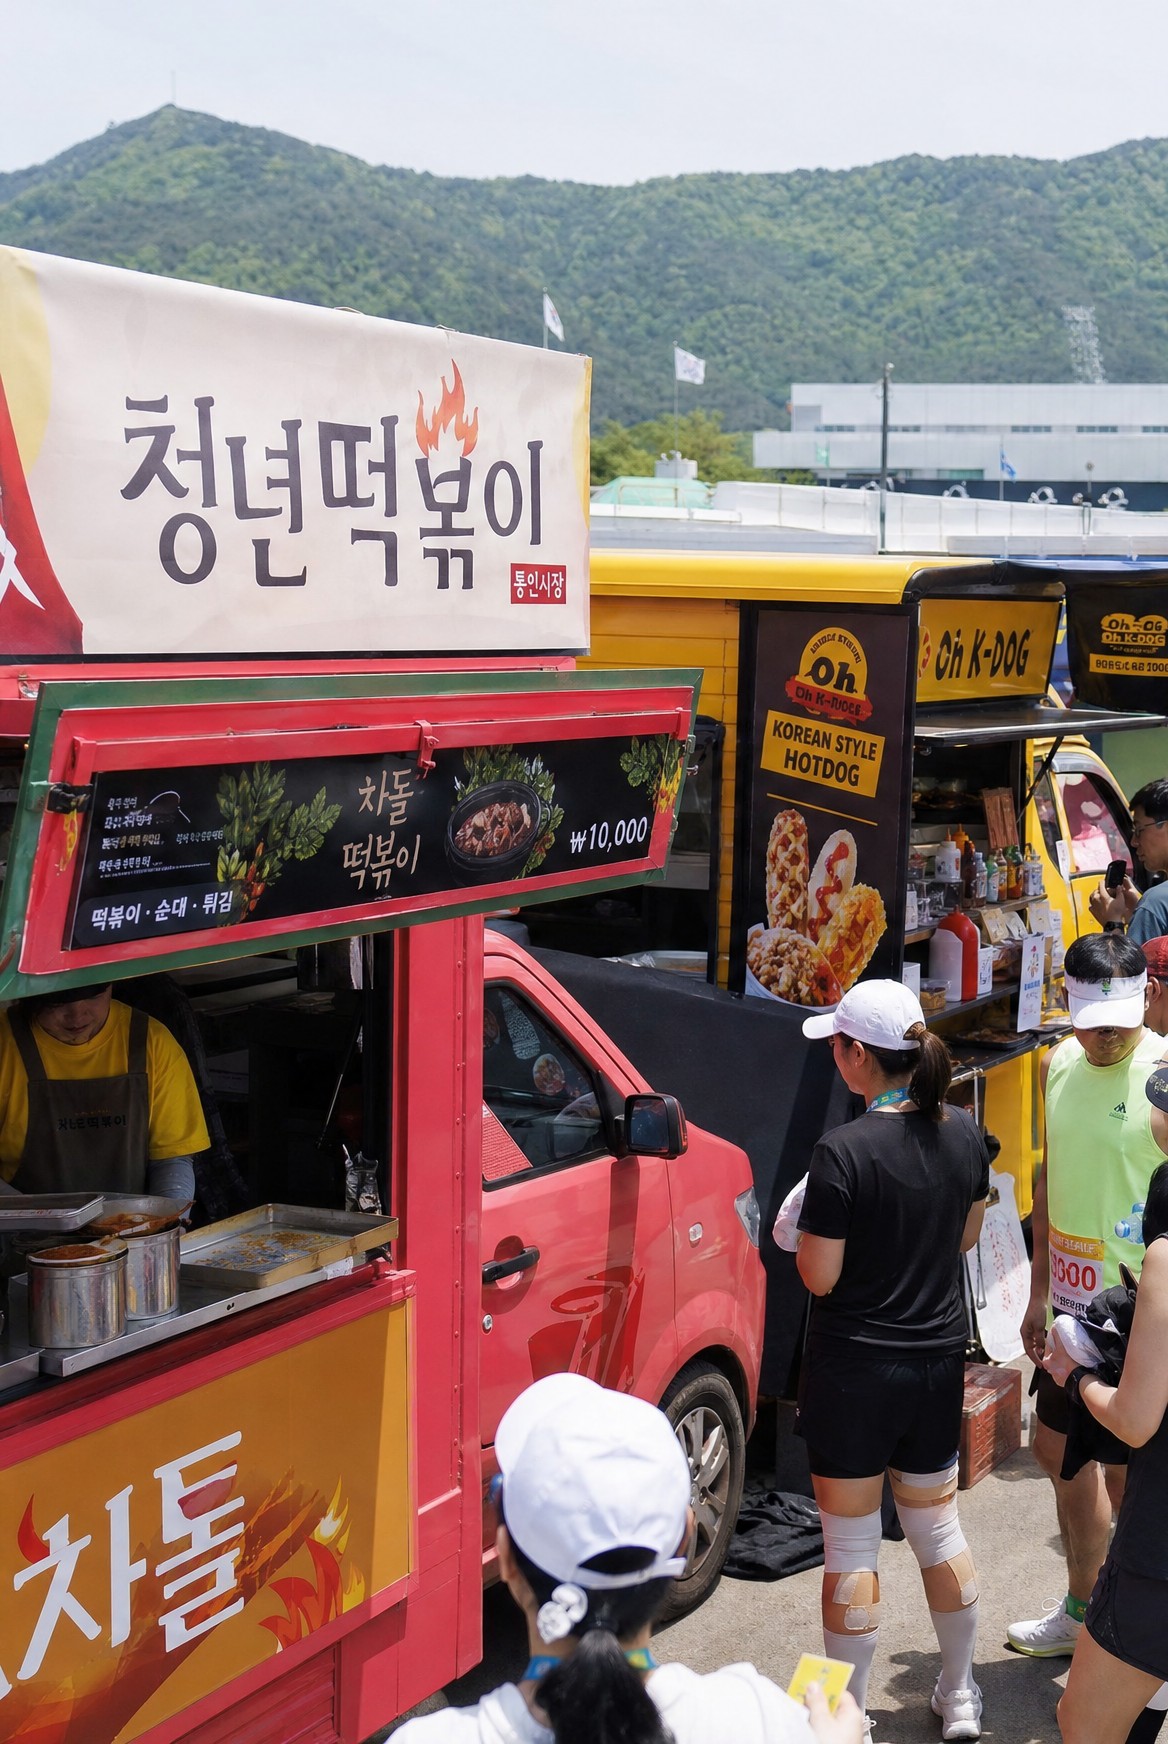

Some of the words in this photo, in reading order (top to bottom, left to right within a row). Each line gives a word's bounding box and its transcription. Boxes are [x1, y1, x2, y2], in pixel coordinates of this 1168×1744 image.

[120, 394, 544, 590] 청년떡볶이
[513, 570, 565, 599] 통인시장
[804, 656, 858, 694] Oh
[936, 628, 964, 681] Oh
[967, 628, 1031, 679] K-DOG
[772, 719, 832, 750] KOREAN
[834, 735, 878, 761] STYLE
[783, 748, 860, 787] HOTDOG
[358, 768, 414, 826] 차돌
[343, 830, 421, 890] 떡볶이
[91, 903, 142, 932] 떡볶이
[154, 896, 188, 922] 순대
[202, 890, 233, 915] 튀김
